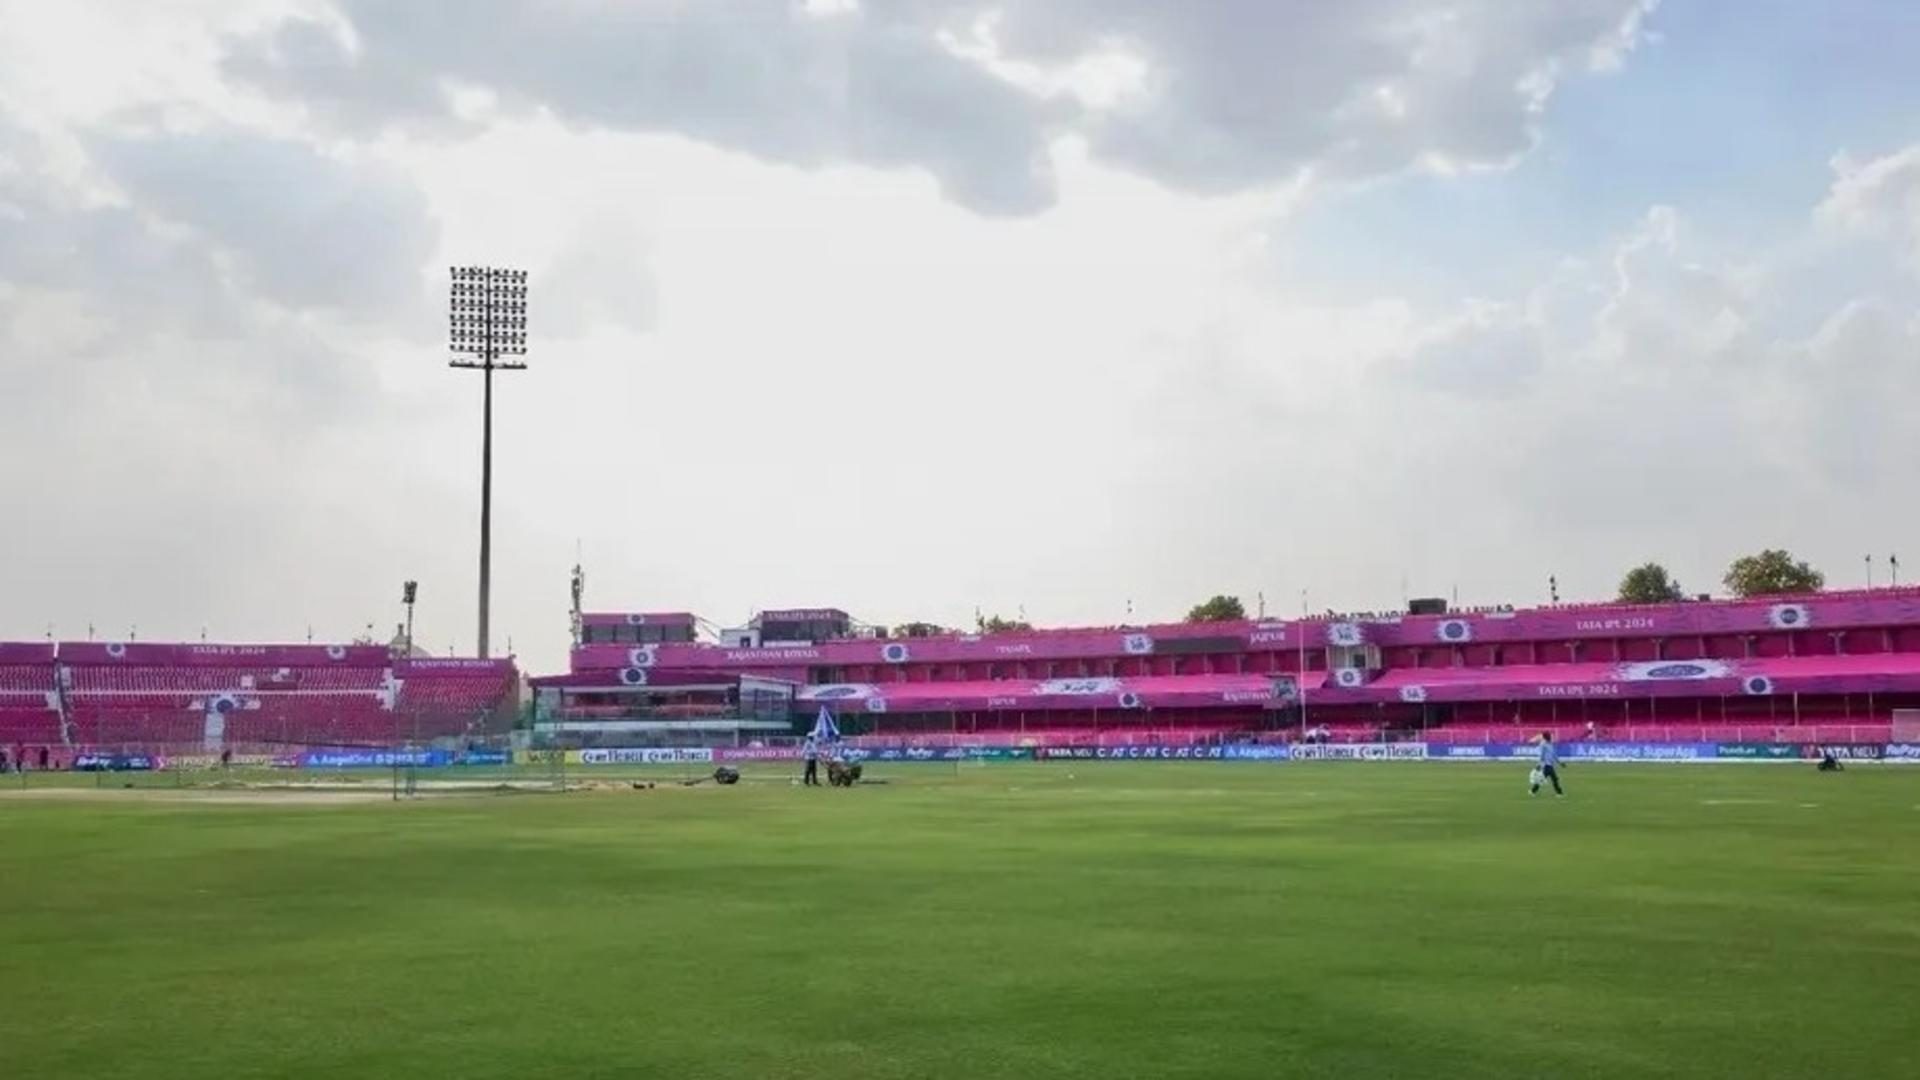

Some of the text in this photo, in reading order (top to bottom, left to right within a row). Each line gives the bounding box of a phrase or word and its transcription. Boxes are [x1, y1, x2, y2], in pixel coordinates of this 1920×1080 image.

[1577, 617, 1654, 630] TATA IPL 2024
[728, 650, 819, 660] RAJASTHAN ROYALS
[1539, 684, 1619, 696] TATA IPL 2024
